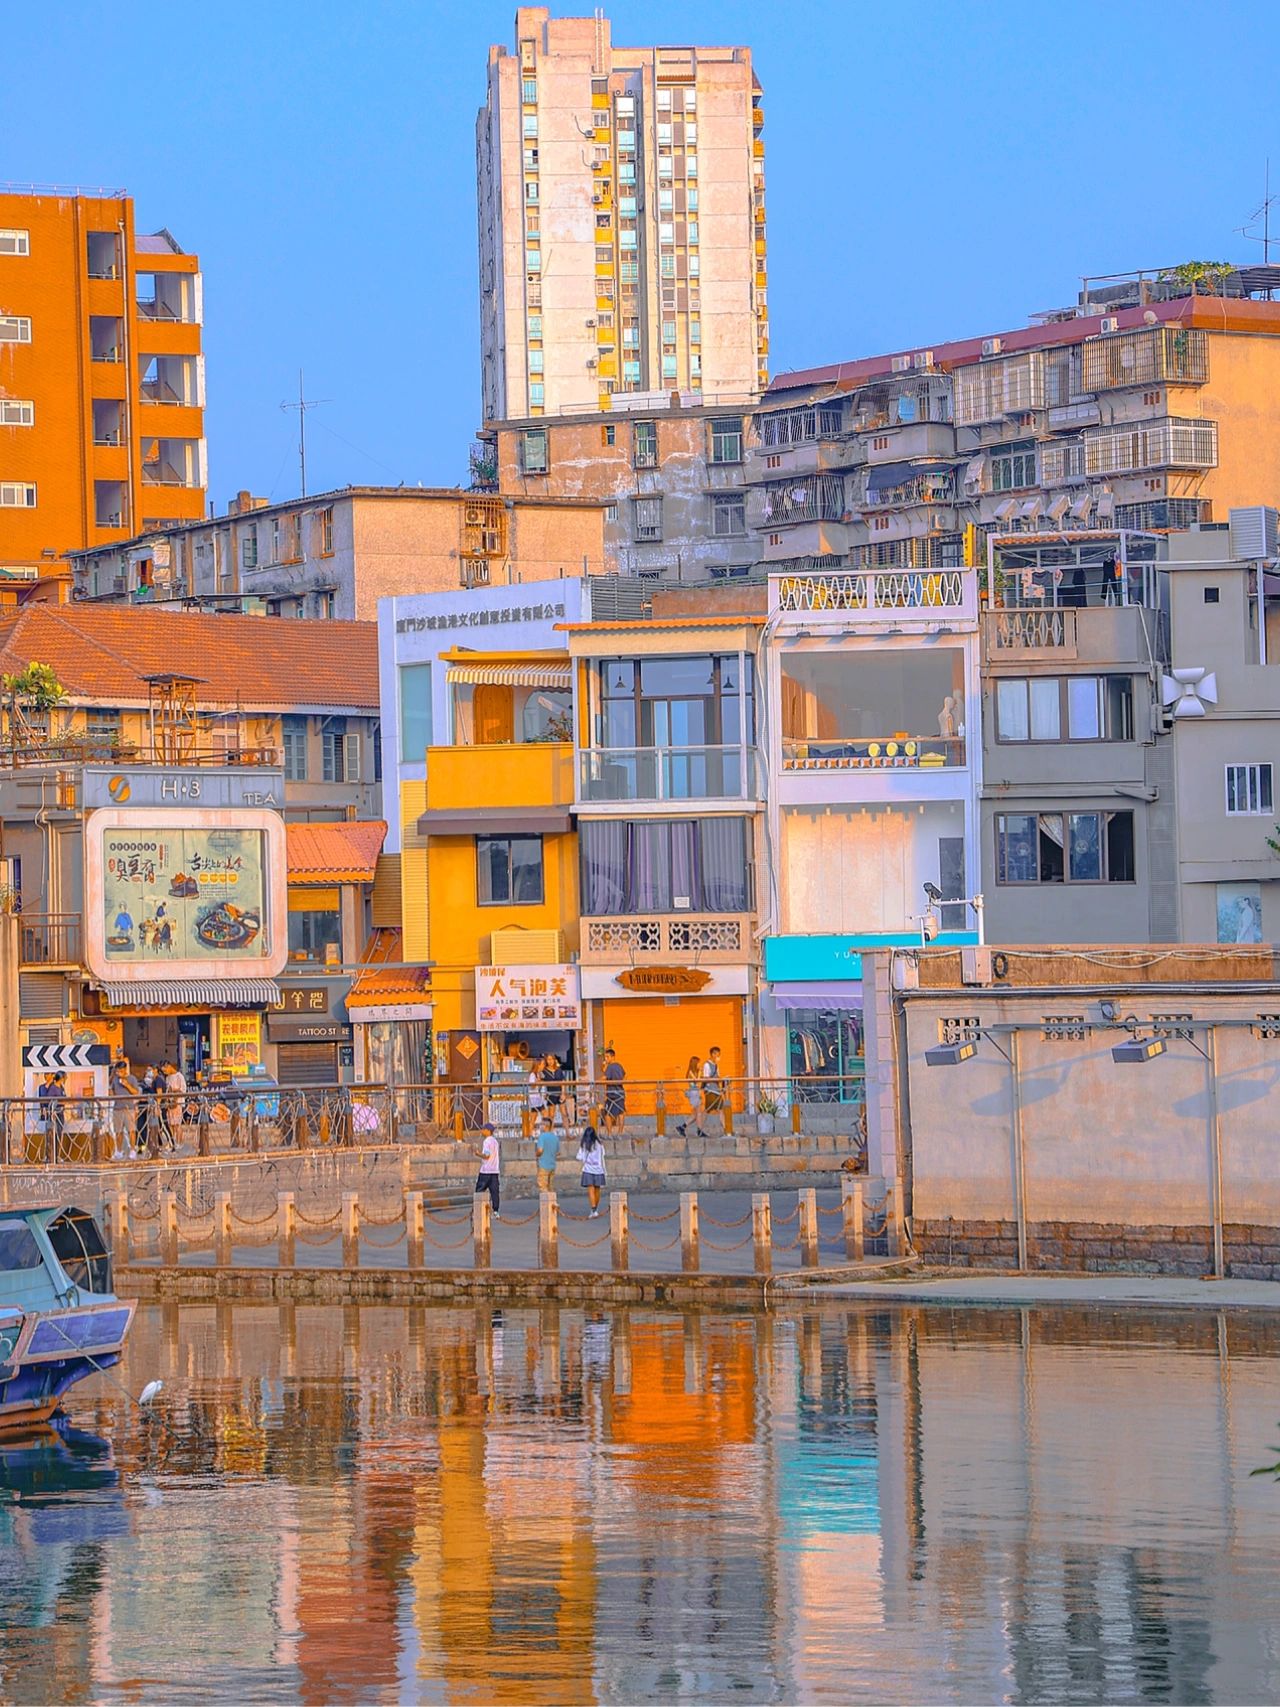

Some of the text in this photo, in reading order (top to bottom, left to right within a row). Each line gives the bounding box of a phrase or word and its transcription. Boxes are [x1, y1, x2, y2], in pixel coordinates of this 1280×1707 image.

[243, 792, 277, 805] TEA
[116, 853, 156, 884] 臭豆腐
[489, 977, 567, 997] 人气泡芙
[298, 1027, 327, 1036] TATTOO
